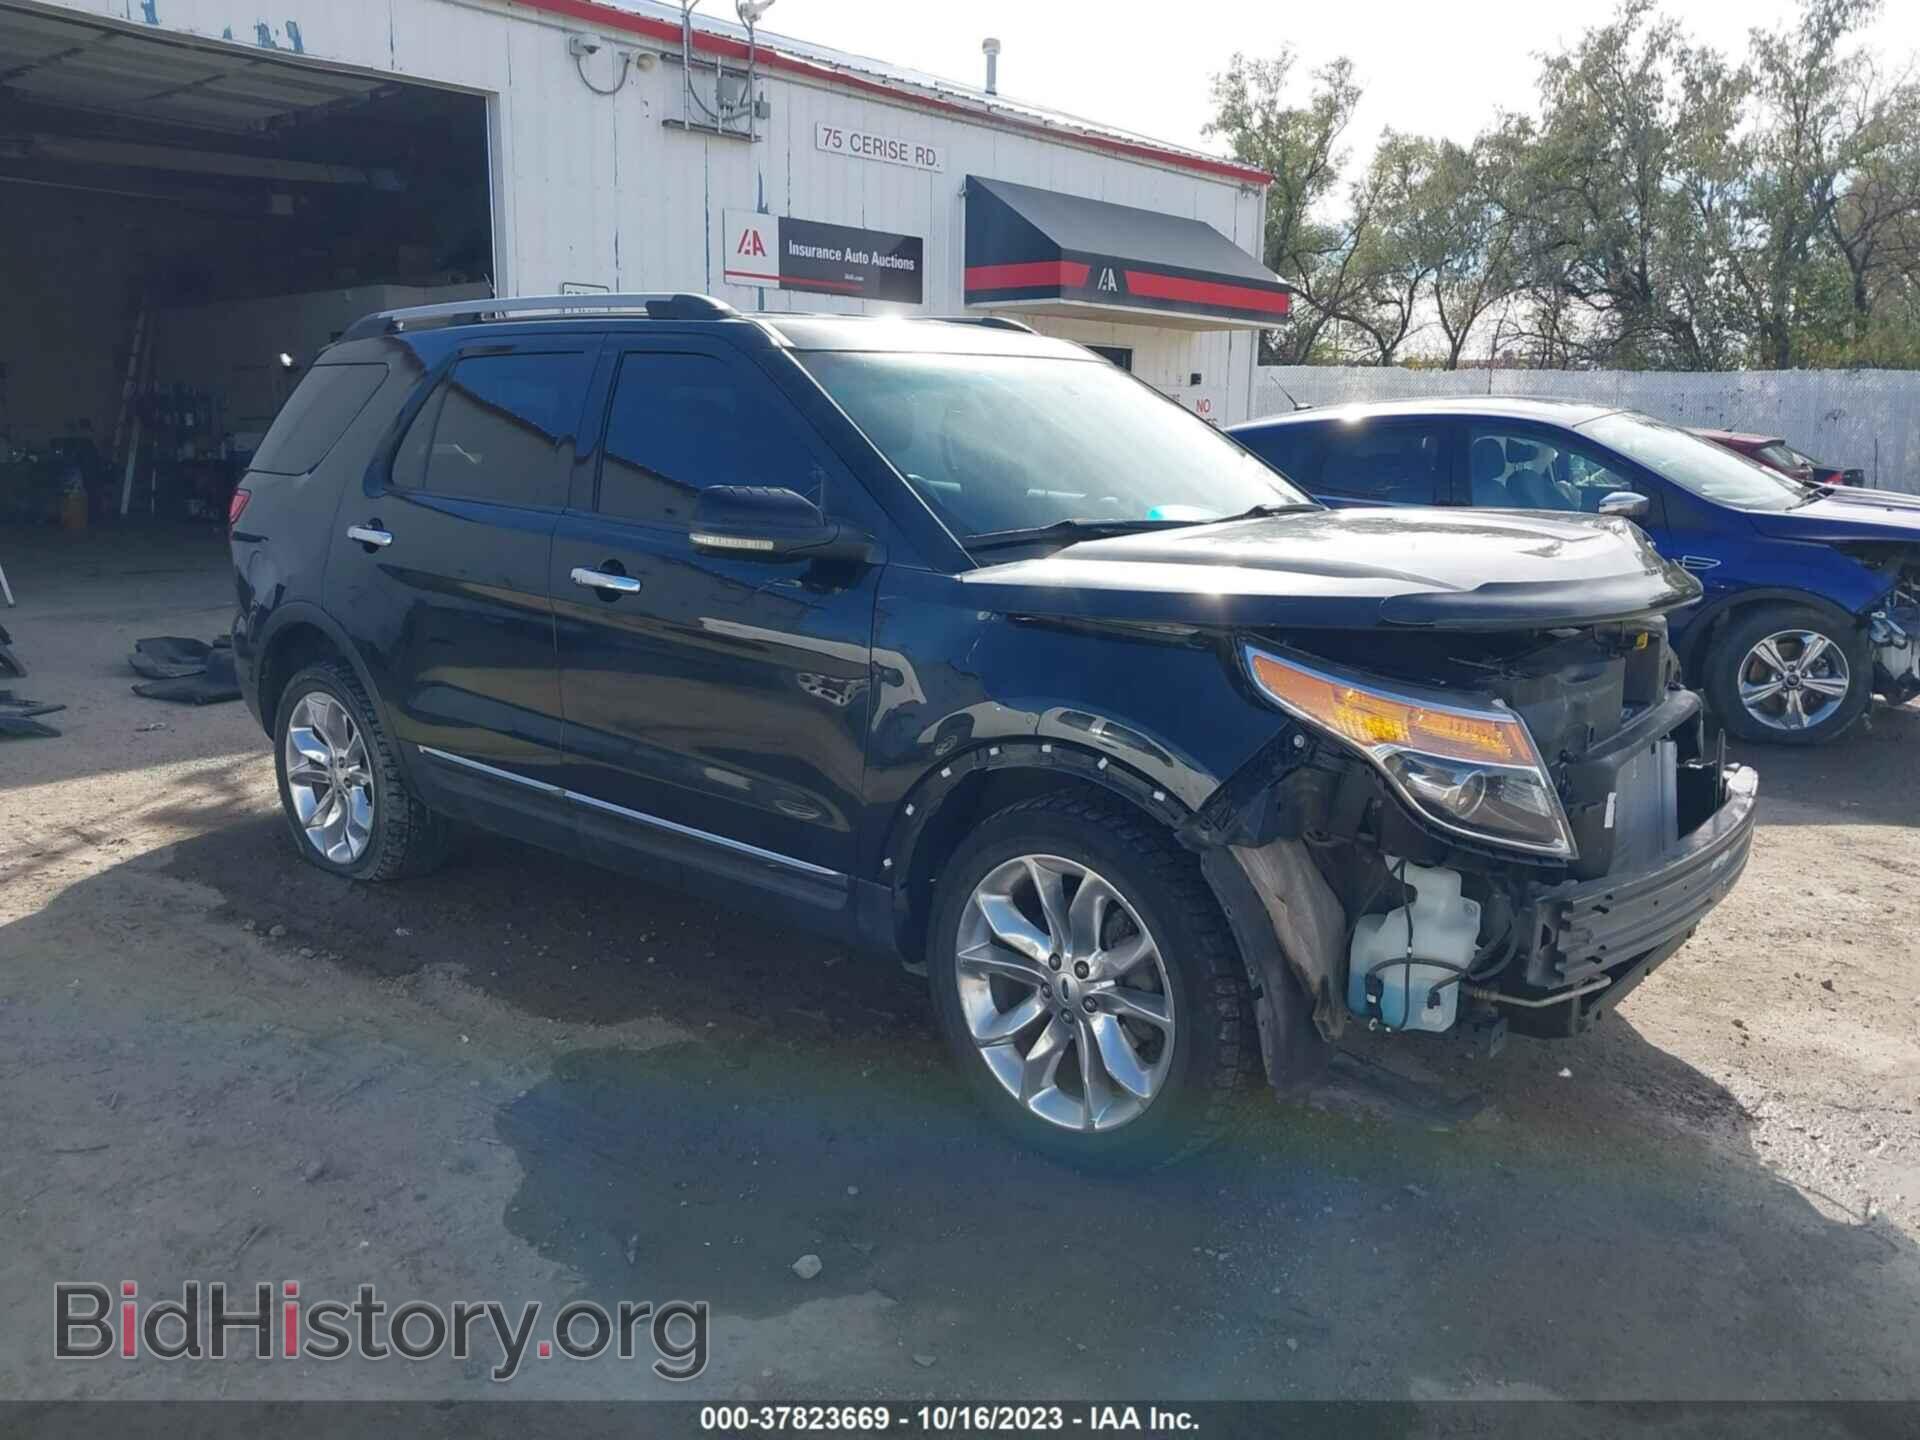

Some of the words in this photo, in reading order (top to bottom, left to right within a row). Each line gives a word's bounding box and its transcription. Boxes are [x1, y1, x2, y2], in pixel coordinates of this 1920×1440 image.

[823, 127, 843, 149] 75
[849, 133, 908, 162] CERISE
[915, 146, 941, 168] RD.
[788, 239, 842, 262] Insurance
[844, 247, 870, 265] Auto
[871, 251, 915, 271] Auctions
[1196, 398, 1211, 413] NO
